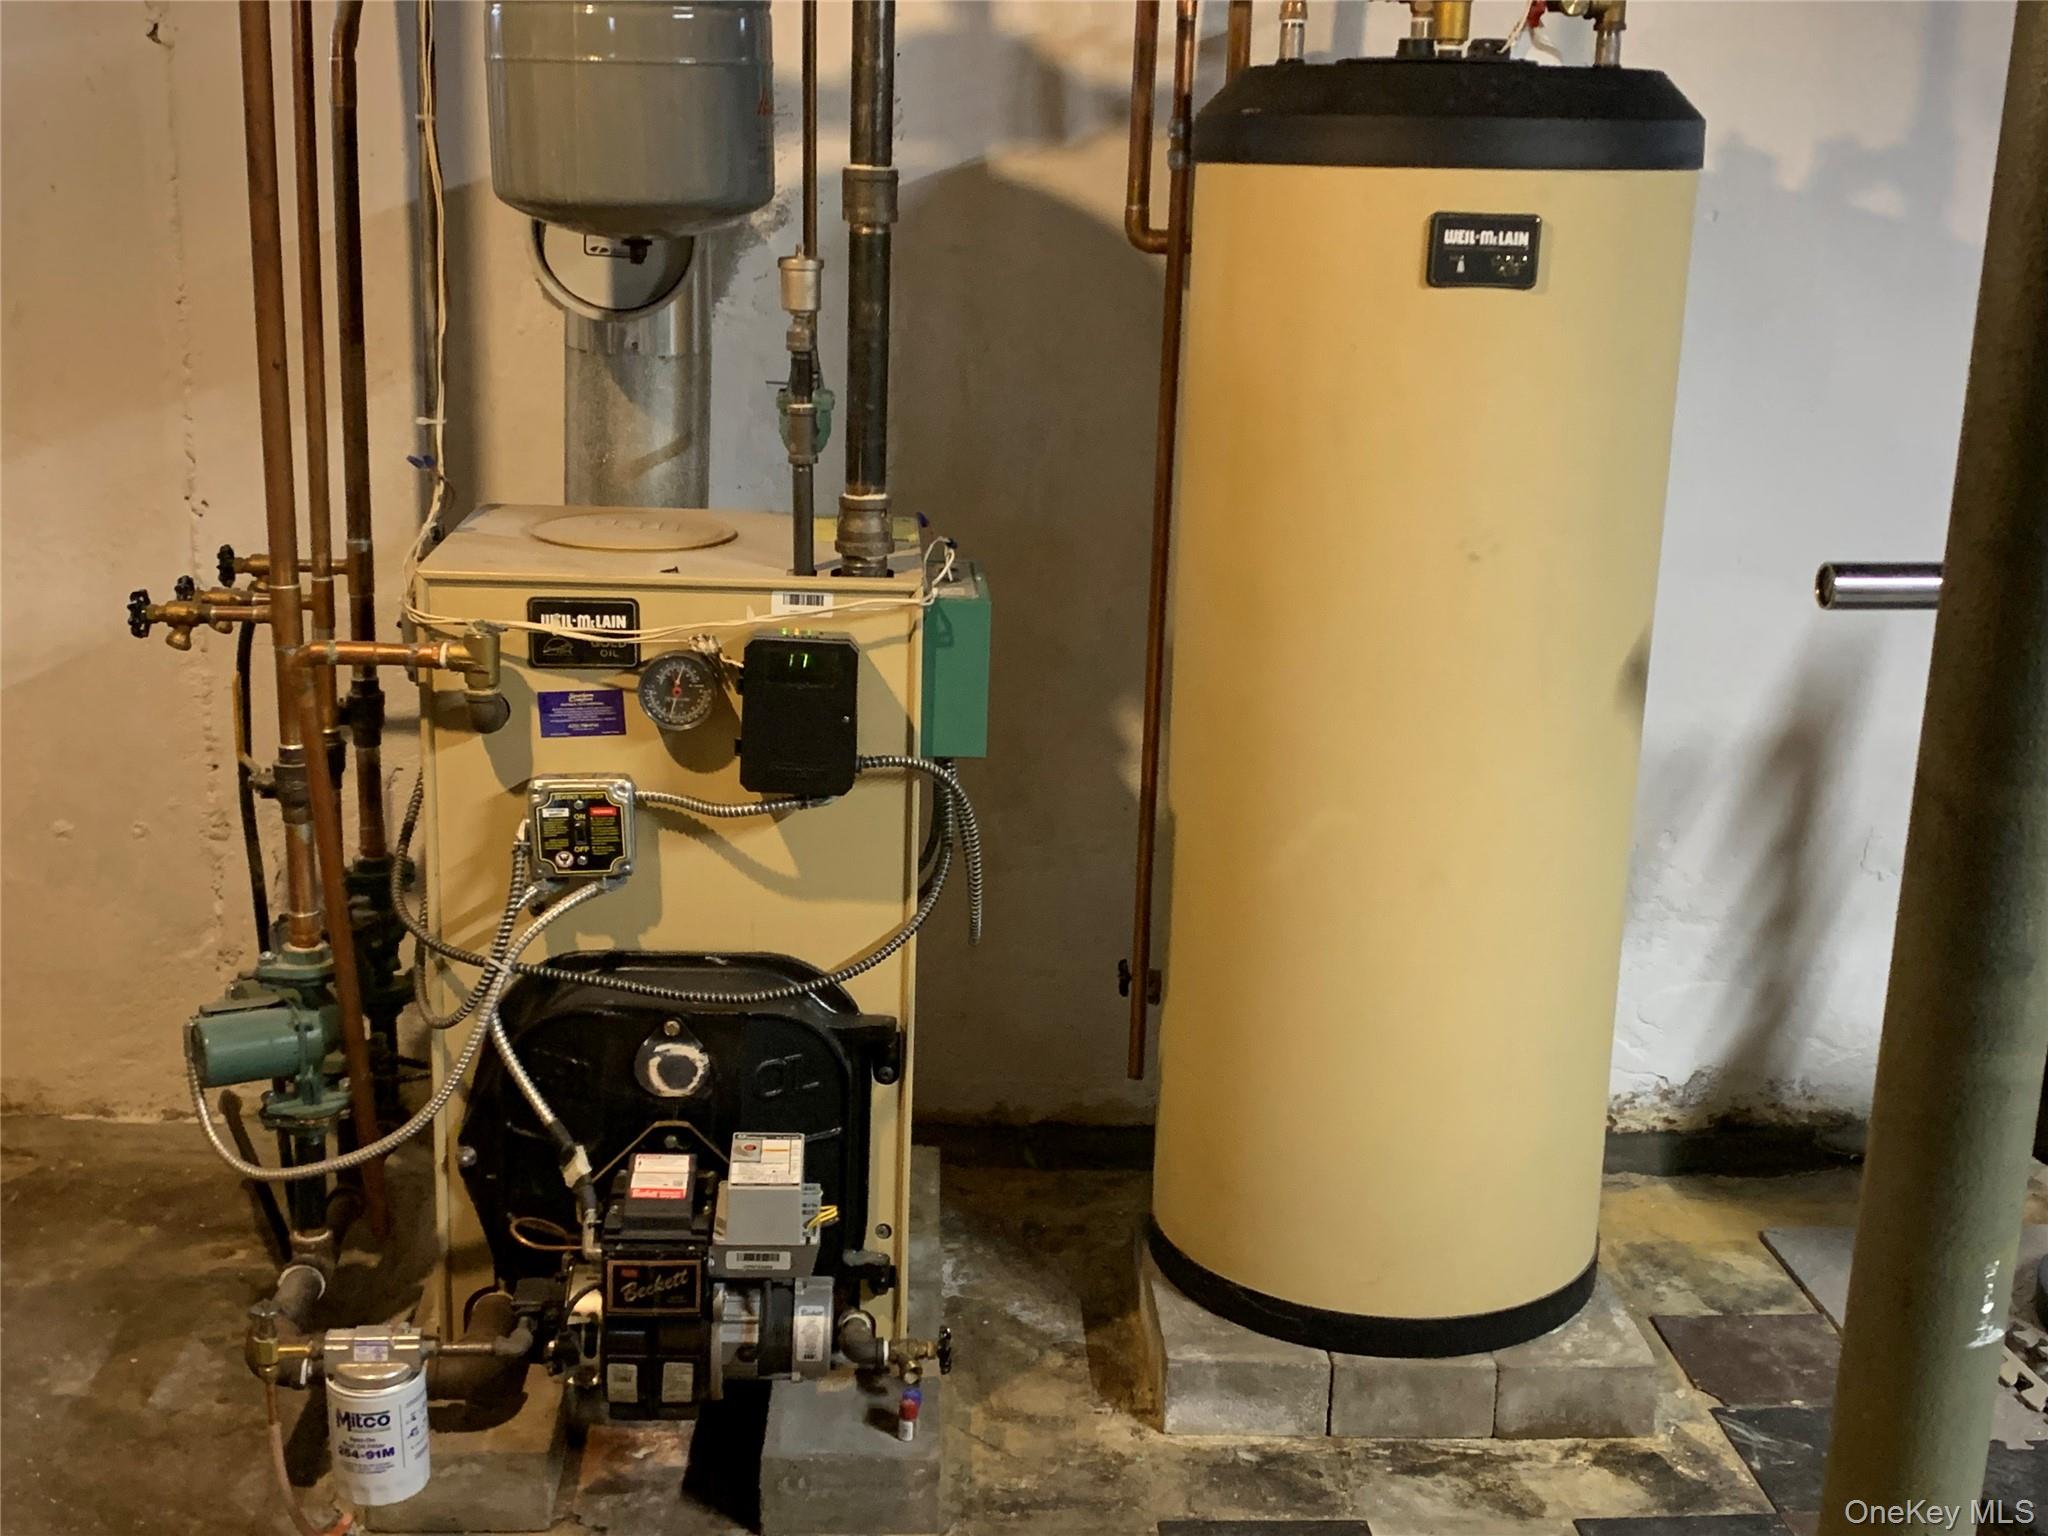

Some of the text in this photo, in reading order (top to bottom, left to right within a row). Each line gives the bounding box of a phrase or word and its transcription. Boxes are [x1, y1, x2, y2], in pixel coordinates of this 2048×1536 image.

[600, 649, 619, 658] OIL
[620, 1269, 689, 1302] Beckett
[336, 1407, 391, 1432] Mitco
